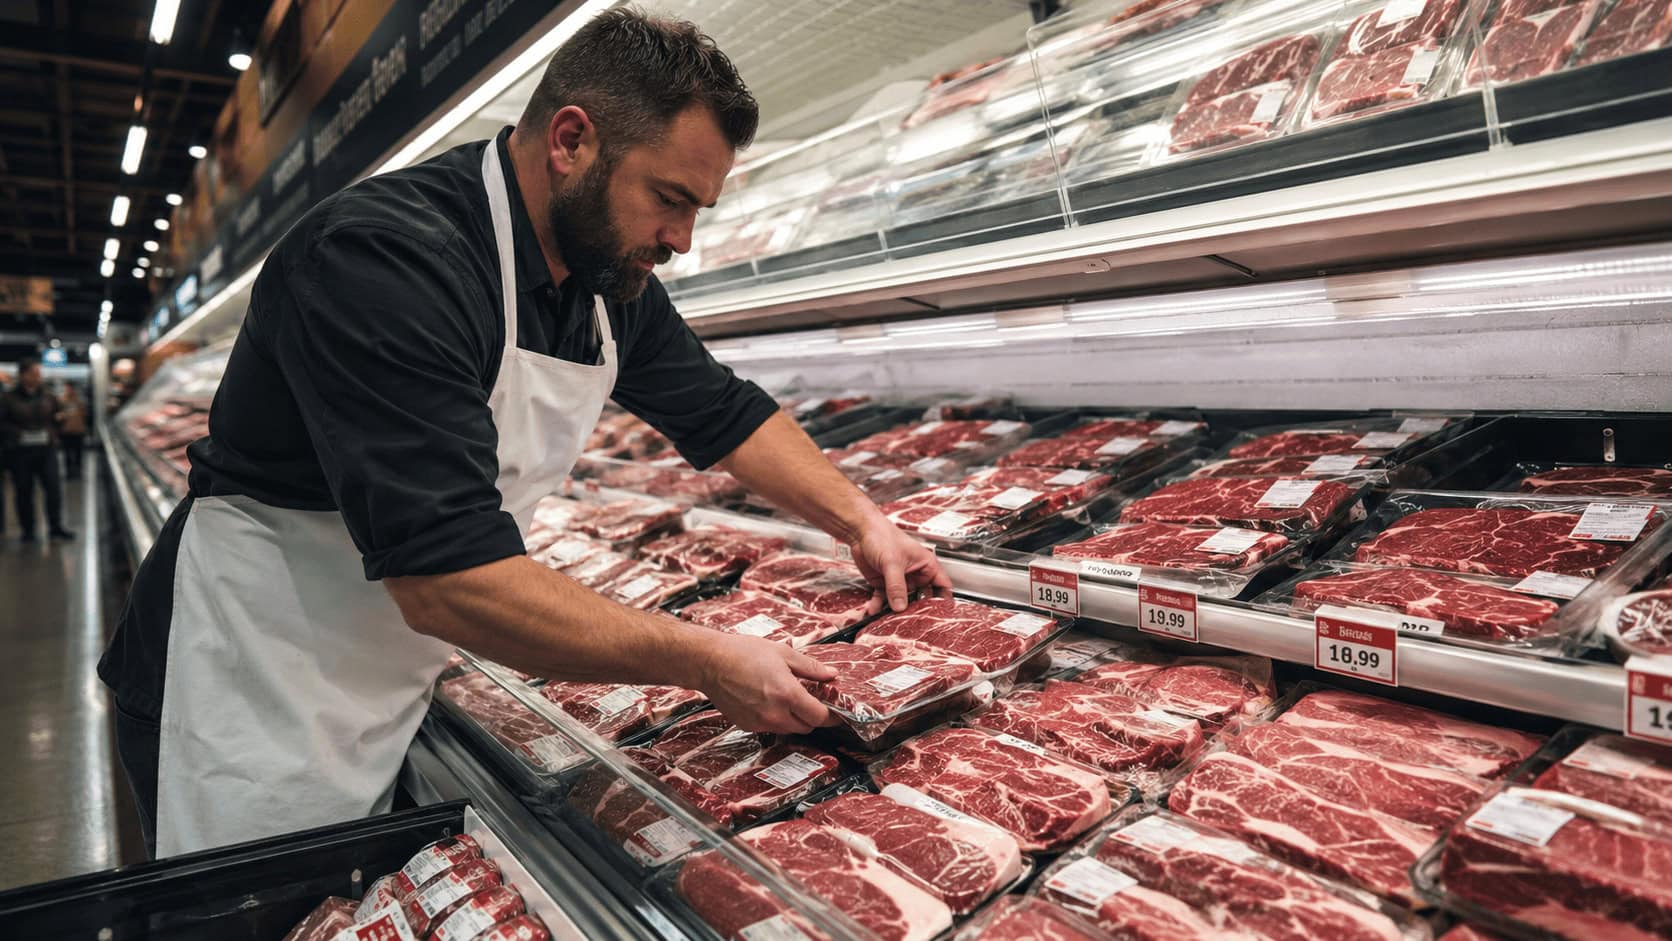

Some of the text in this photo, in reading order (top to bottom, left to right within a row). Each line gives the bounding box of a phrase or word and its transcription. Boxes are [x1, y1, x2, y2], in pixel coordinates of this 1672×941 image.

[1038, 587, 1069, 604] 18.99
[1149, 609, 1185, 628] 19.99
[1329, 644, 1380, 668] 18.99
